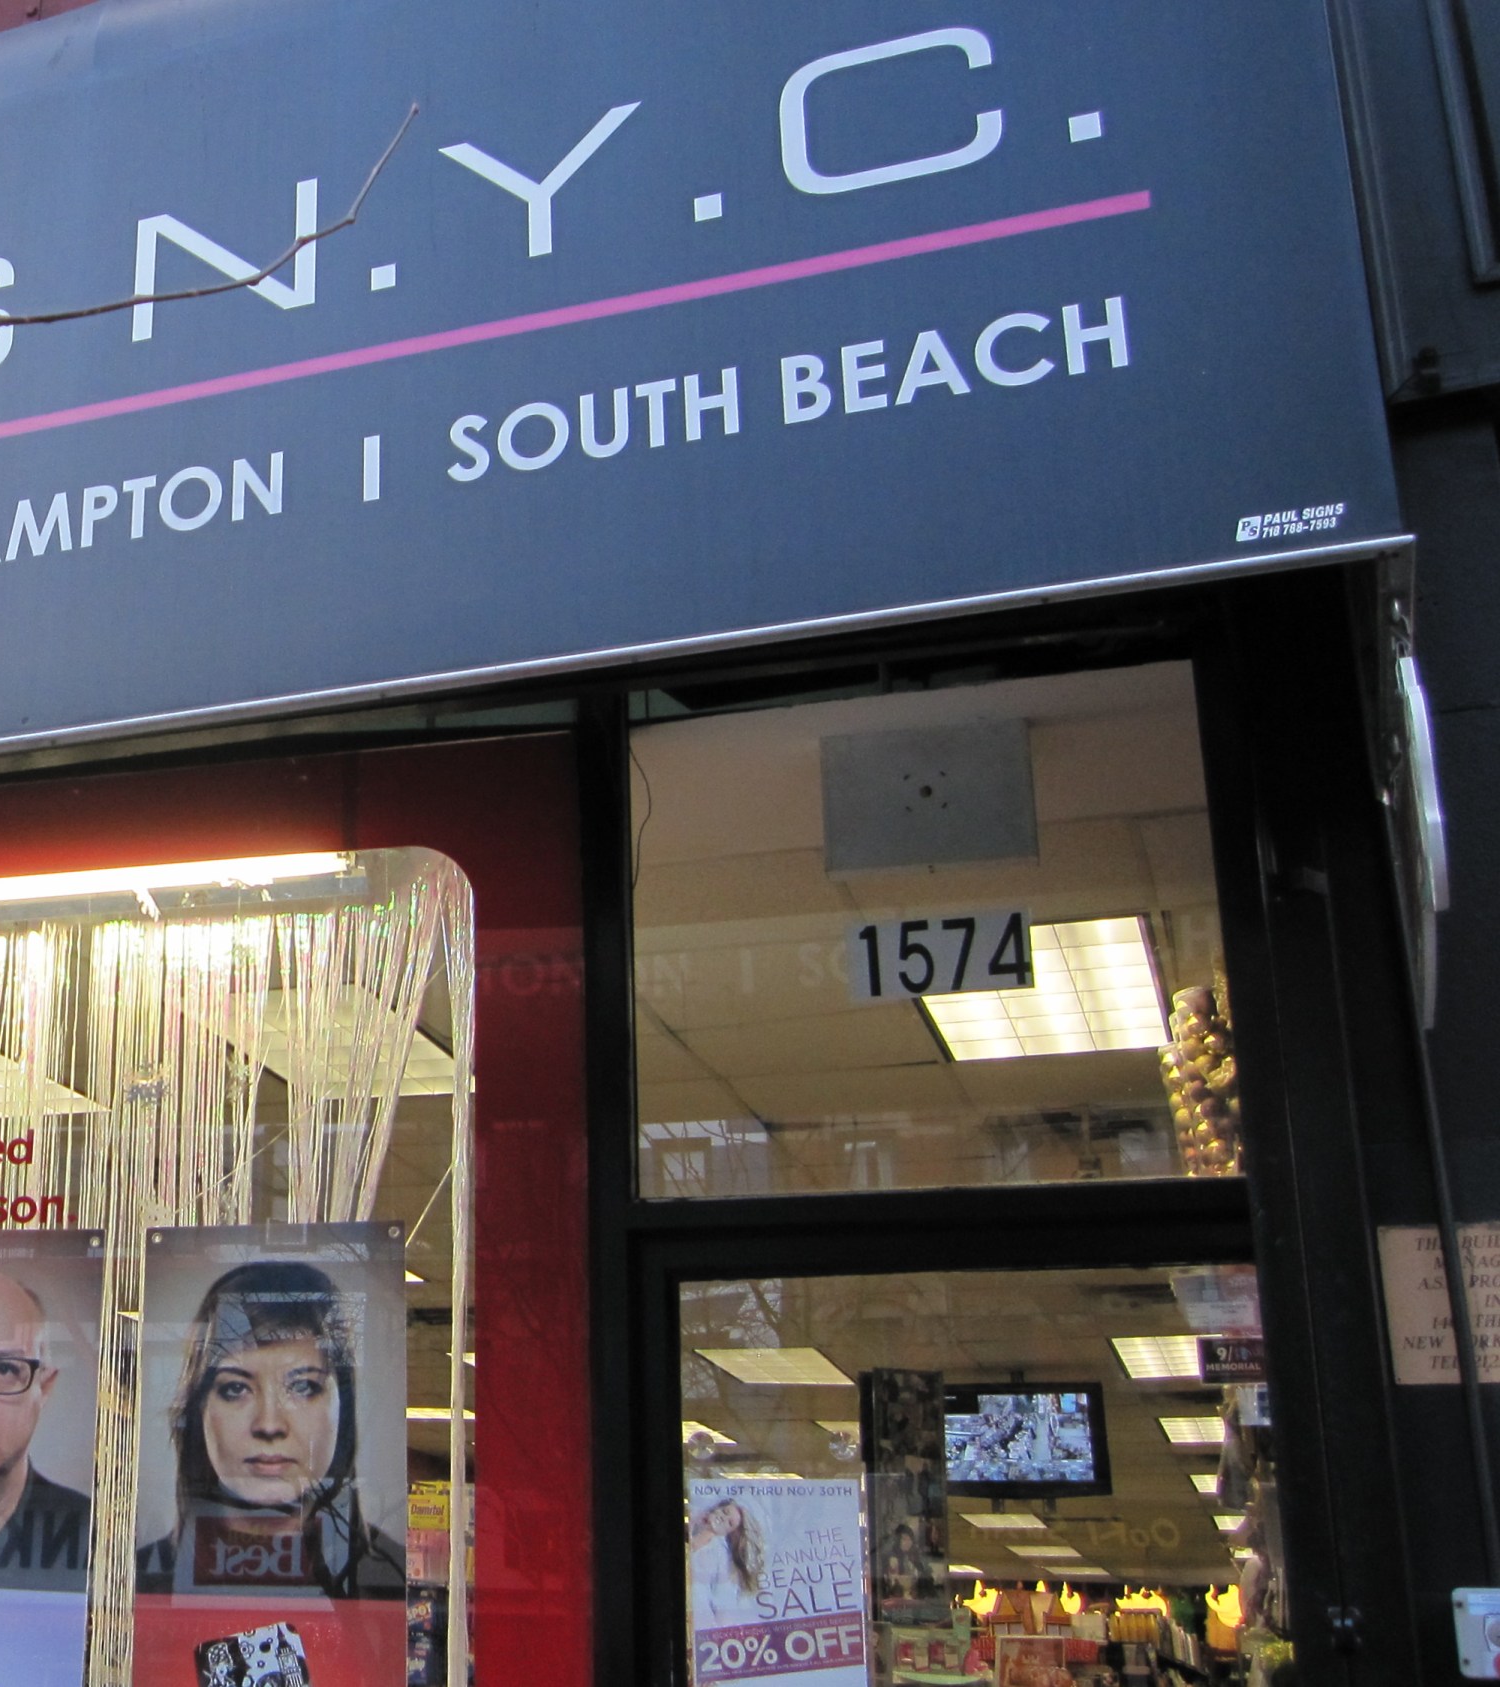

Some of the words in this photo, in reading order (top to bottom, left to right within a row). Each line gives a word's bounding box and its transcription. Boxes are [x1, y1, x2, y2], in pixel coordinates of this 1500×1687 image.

[447, 366, 740, 483] SOUTH
[781, 295, 1129, 424] BEACH
[1263, 510, 1298, 525] PAUL
[1302, 503, 1344, 520] SIGNS
[1262, 527, 1280, 538] 718
[857, 911, 1032, 998] 1574
[1403, 1335, 1445, 1350] NEW
[1206, 1362, 1261, 1372] MEMORIAL
[694, 1486, 721, 1496] NOV
[750, 1486, 783, 1496] THRU
[788, 1486, 815, 1496] NOV
[820, 1486, 852, 1496] 30TH
[805, 1527, 843, 1545] THE
[771, 1545, 854, 1567] ANNUAL
[757, 1560, 855, 1590] BEAUTY
[755, 1581, 858, 1620] SALE
[698, 1634, 778, 1673] 20%
[785, 1624, 862, 1661] OFF
